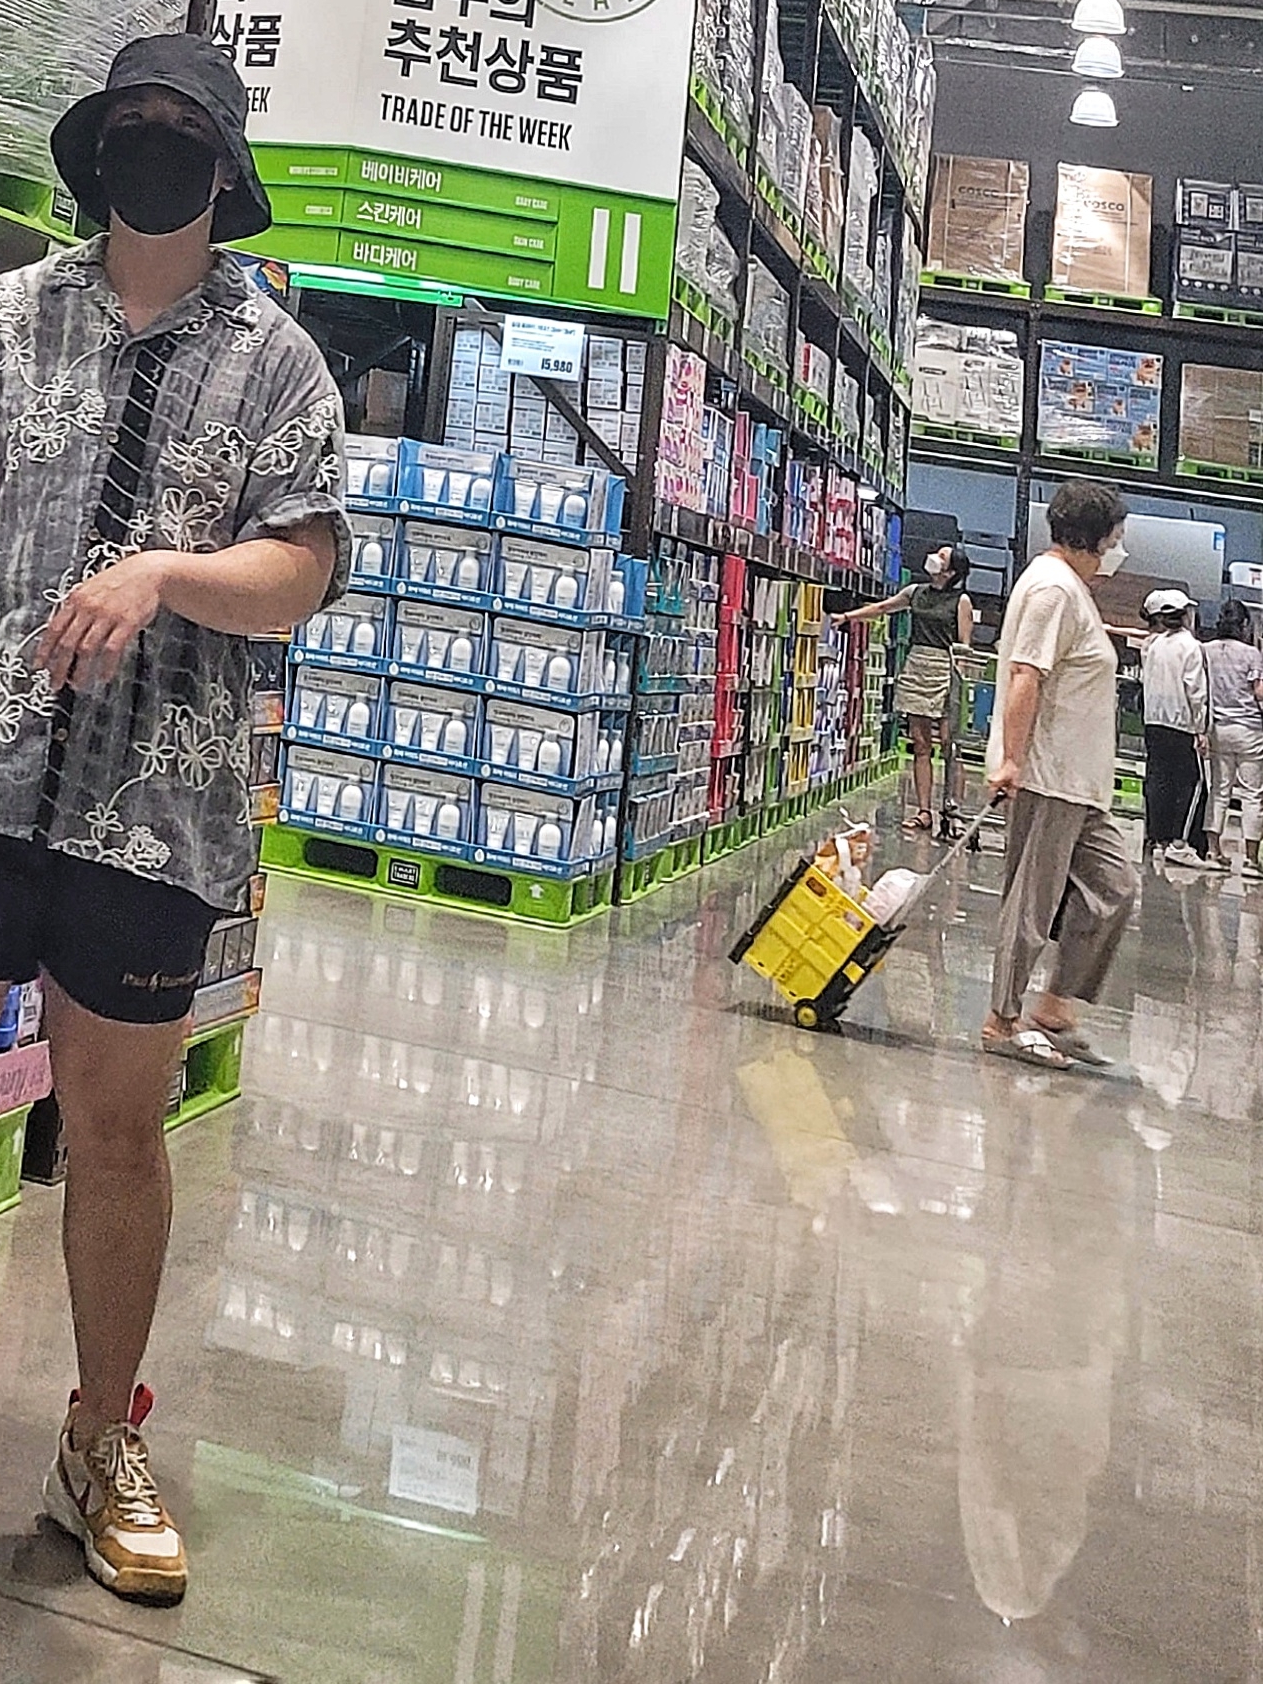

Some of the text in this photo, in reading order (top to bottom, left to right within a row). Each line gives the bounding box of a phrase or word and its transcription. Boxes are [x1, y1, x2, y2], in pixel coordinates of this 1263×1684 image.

[210, 12, 283, 68] 상품
[384, 18, 584, 105] 추천상품
[380, 93, 573, 152] TRADE OF THE WEEK
[361, 159, 443, 193] 베이비케어
[356, 199, 422, 230] 스킨케어
[352, 241, 418, 271] 바디케어
[540, 357, 574, 374] 15,980
